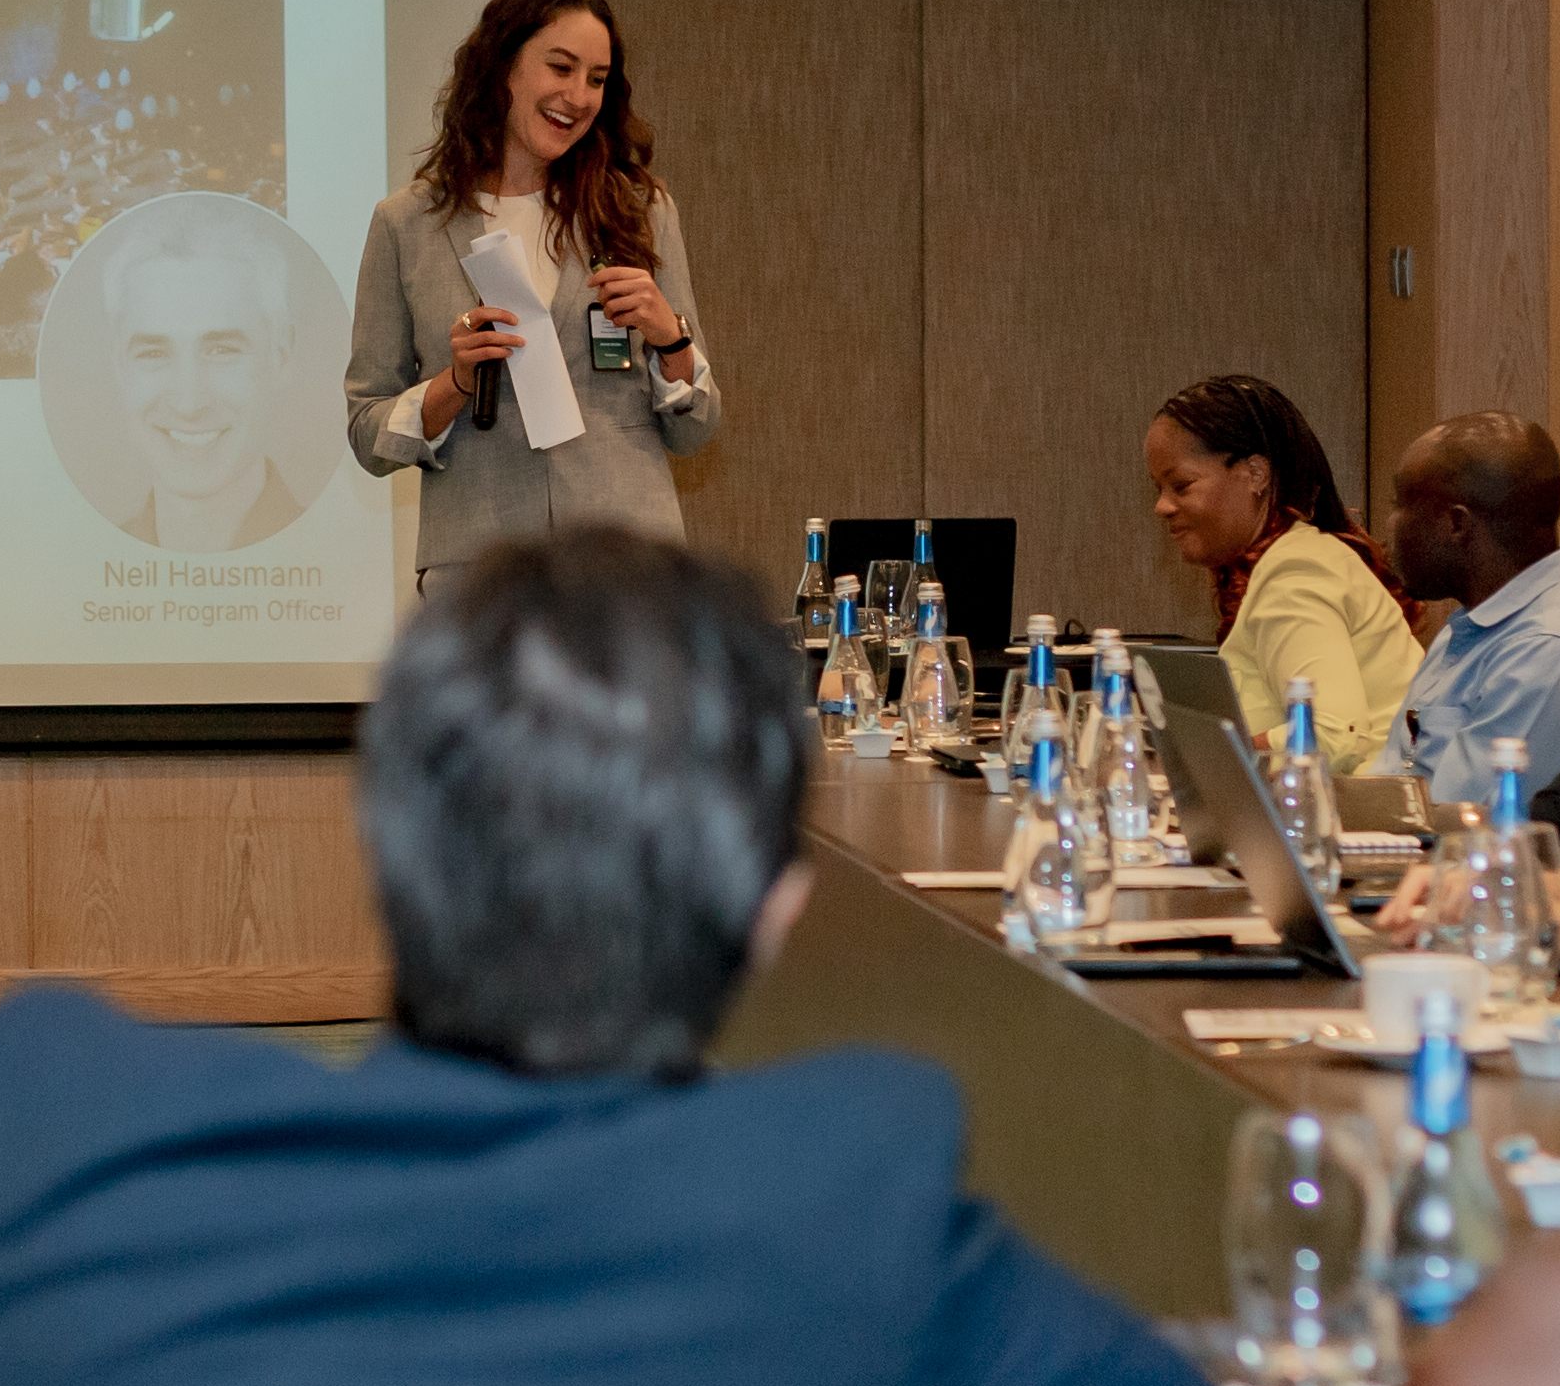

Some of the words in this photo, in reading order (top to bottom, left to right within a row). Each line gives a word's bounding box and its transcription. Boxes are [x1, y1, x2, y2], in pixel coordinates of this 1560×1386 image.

[104, 561, 158, 588] Neil
[169, 561, 322, 587] Hausmann
[83, 600, 154, 622] Senior
[163, 600, 259, 627] Program
[267, 599, 344, 621] Officer
